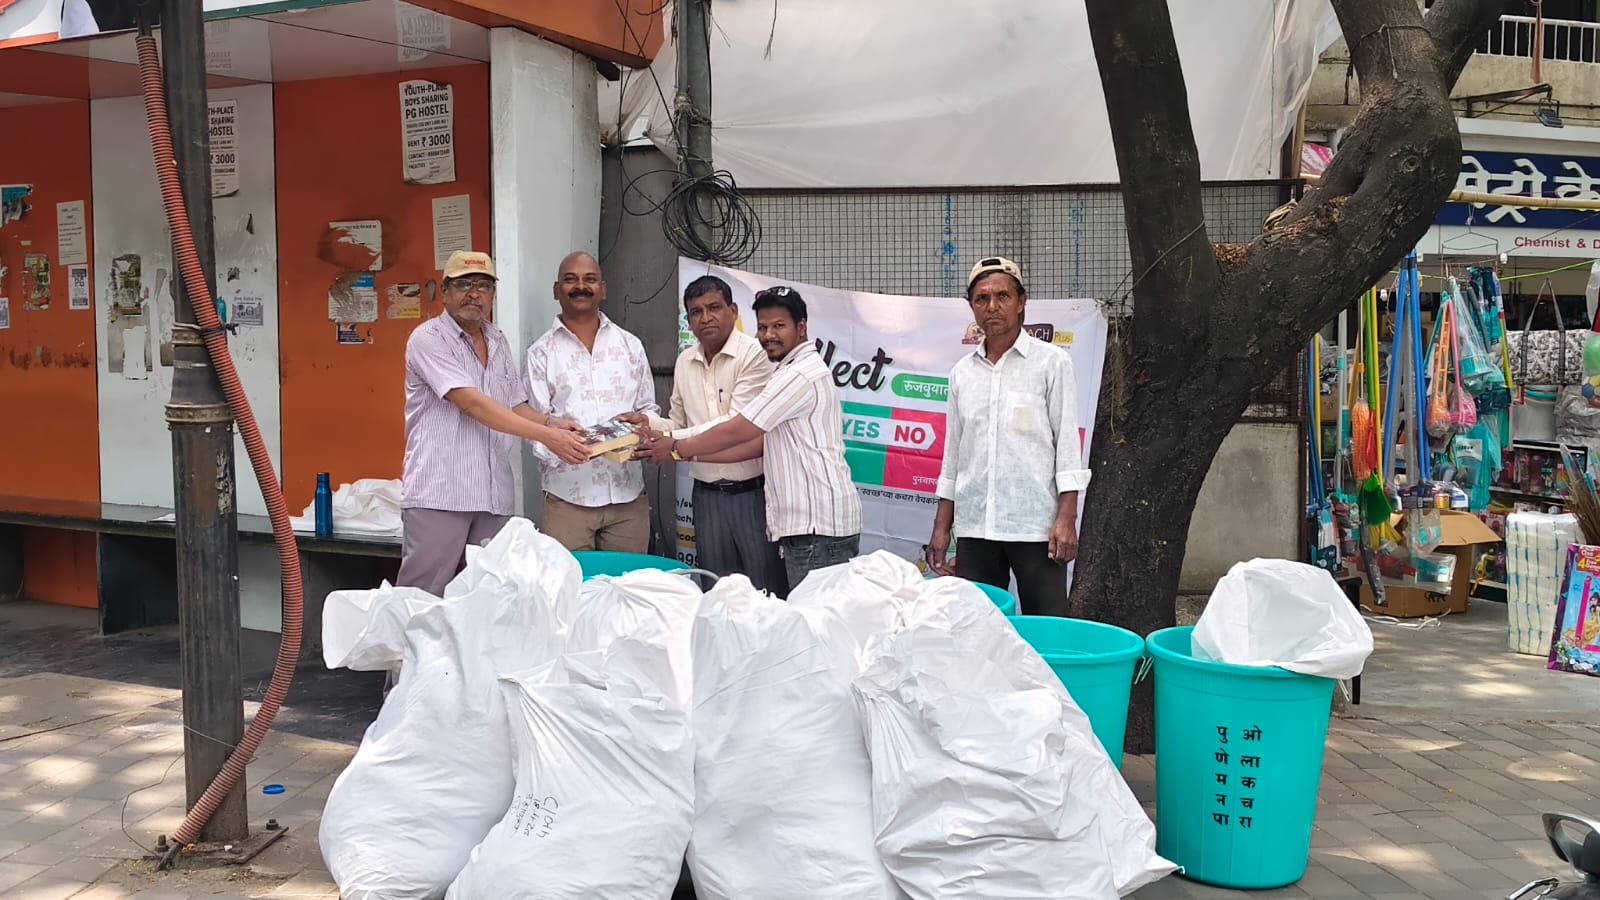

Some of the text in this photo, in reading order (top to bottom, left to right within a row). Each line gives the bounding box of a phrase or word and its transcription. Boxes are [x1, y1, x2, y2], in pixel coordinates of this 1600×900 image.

[404, 93, 449, 107] BOYS SHARING
[405, 103, 449, 119] PG HOSTEL
[211, 116, 234, 125] SHARING
[428, 133, 451, 146] 3000
[215, 153, 235, 164] 3000
[1514, 236, 1570, 248] Chemist
[1577, 238, 1586, 249] &
[842, 418, 926, 445] YES NO
